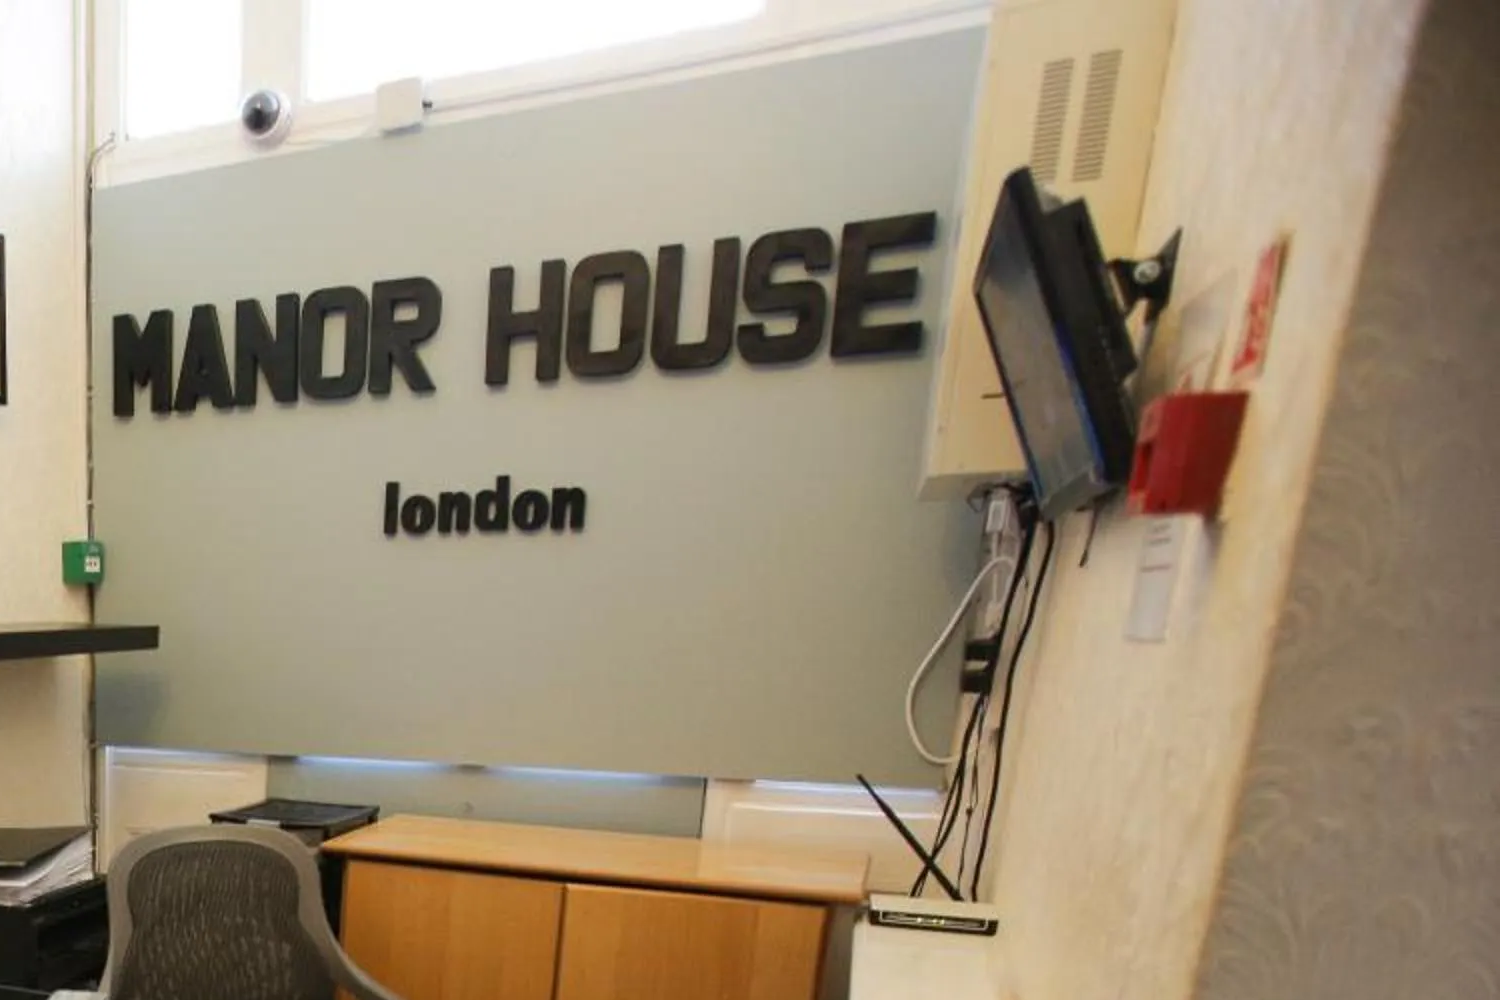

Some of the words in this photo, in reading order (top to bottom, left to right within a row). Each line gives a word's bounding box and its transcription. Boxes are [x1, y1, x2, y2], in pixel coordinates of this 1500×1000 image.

[112, 276, 442, 417] MANOR
[485, 210, 937, 386] HOUSE
[383, 474, 587, 537] london
